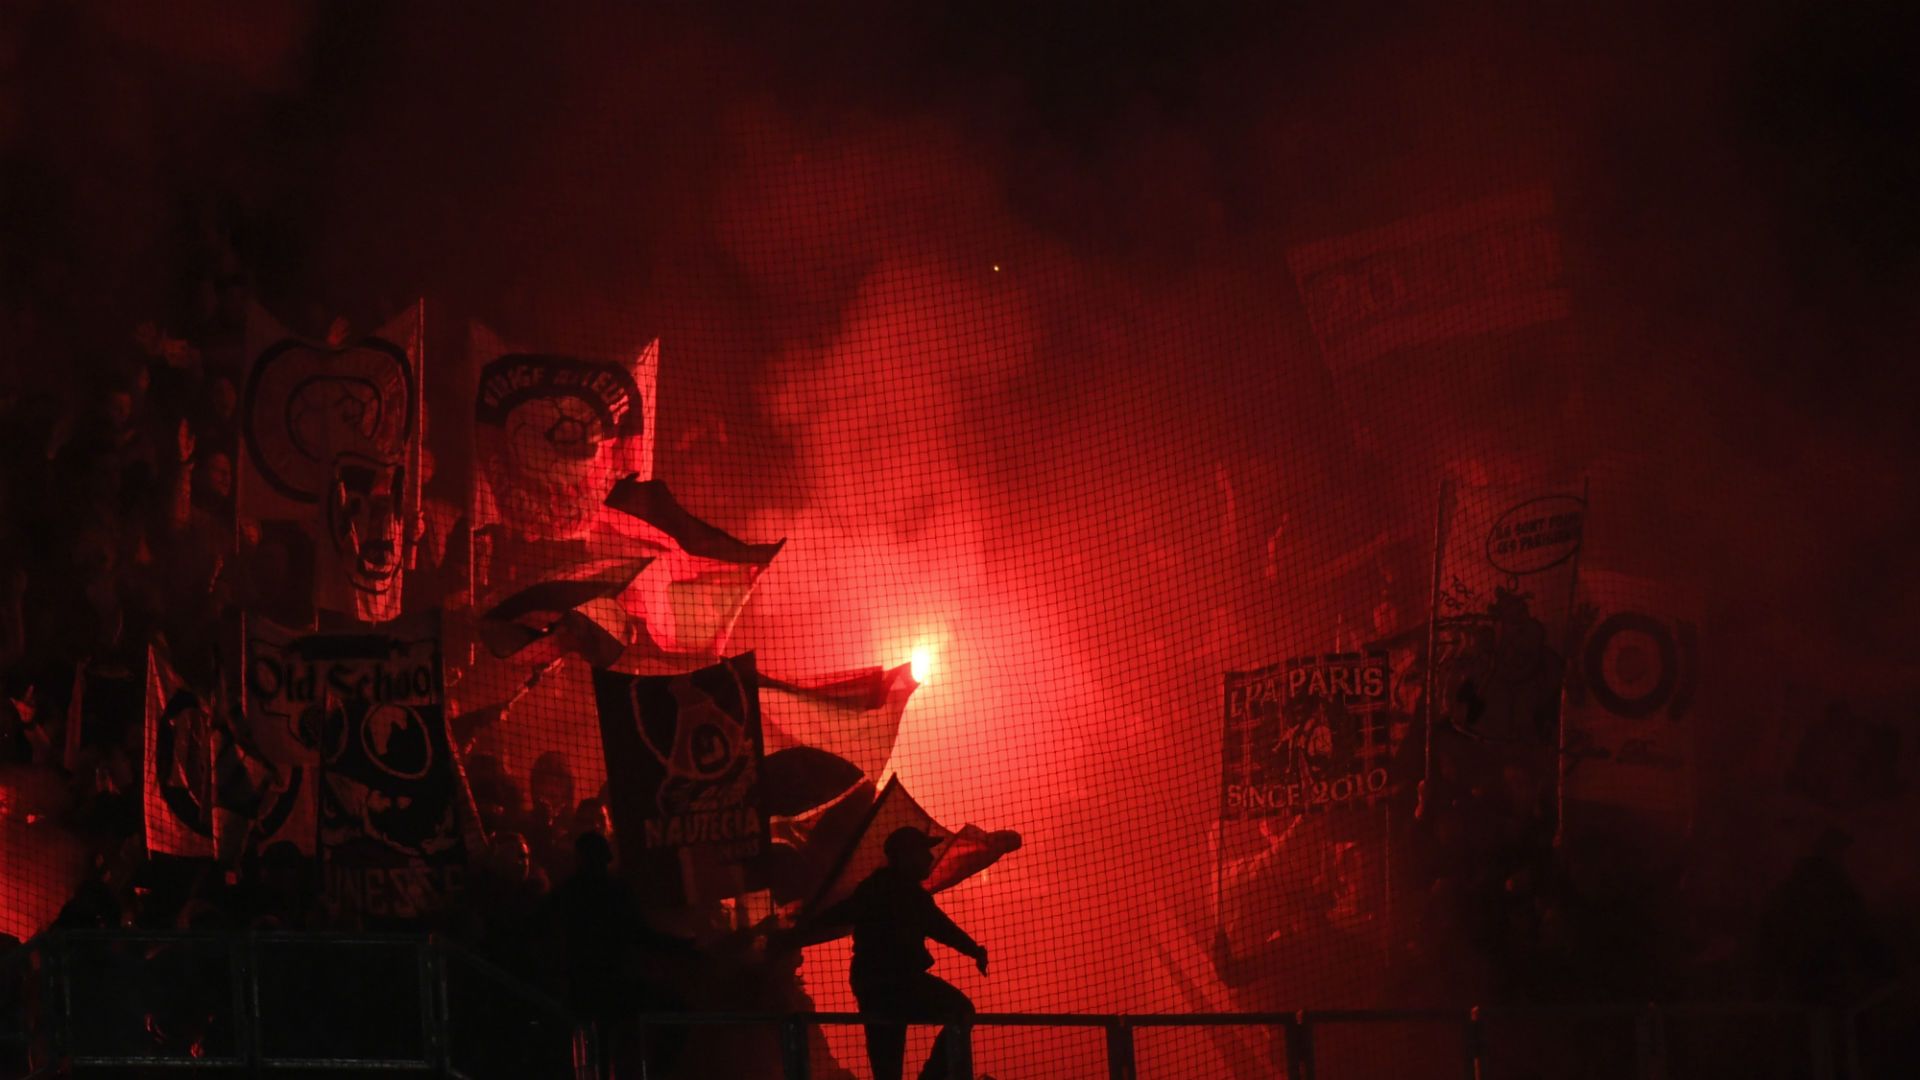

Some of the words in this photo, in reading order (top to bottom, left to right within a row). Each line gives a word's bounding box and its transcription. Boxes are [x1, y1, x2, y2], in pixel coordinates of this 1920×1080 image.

[252, 657, 316, 701] Old
[1289, 667, 1383, 698] PARIS
[1228, 783, 1299, 807] SINCE
[1313, 767, 1388, 804] 2010
